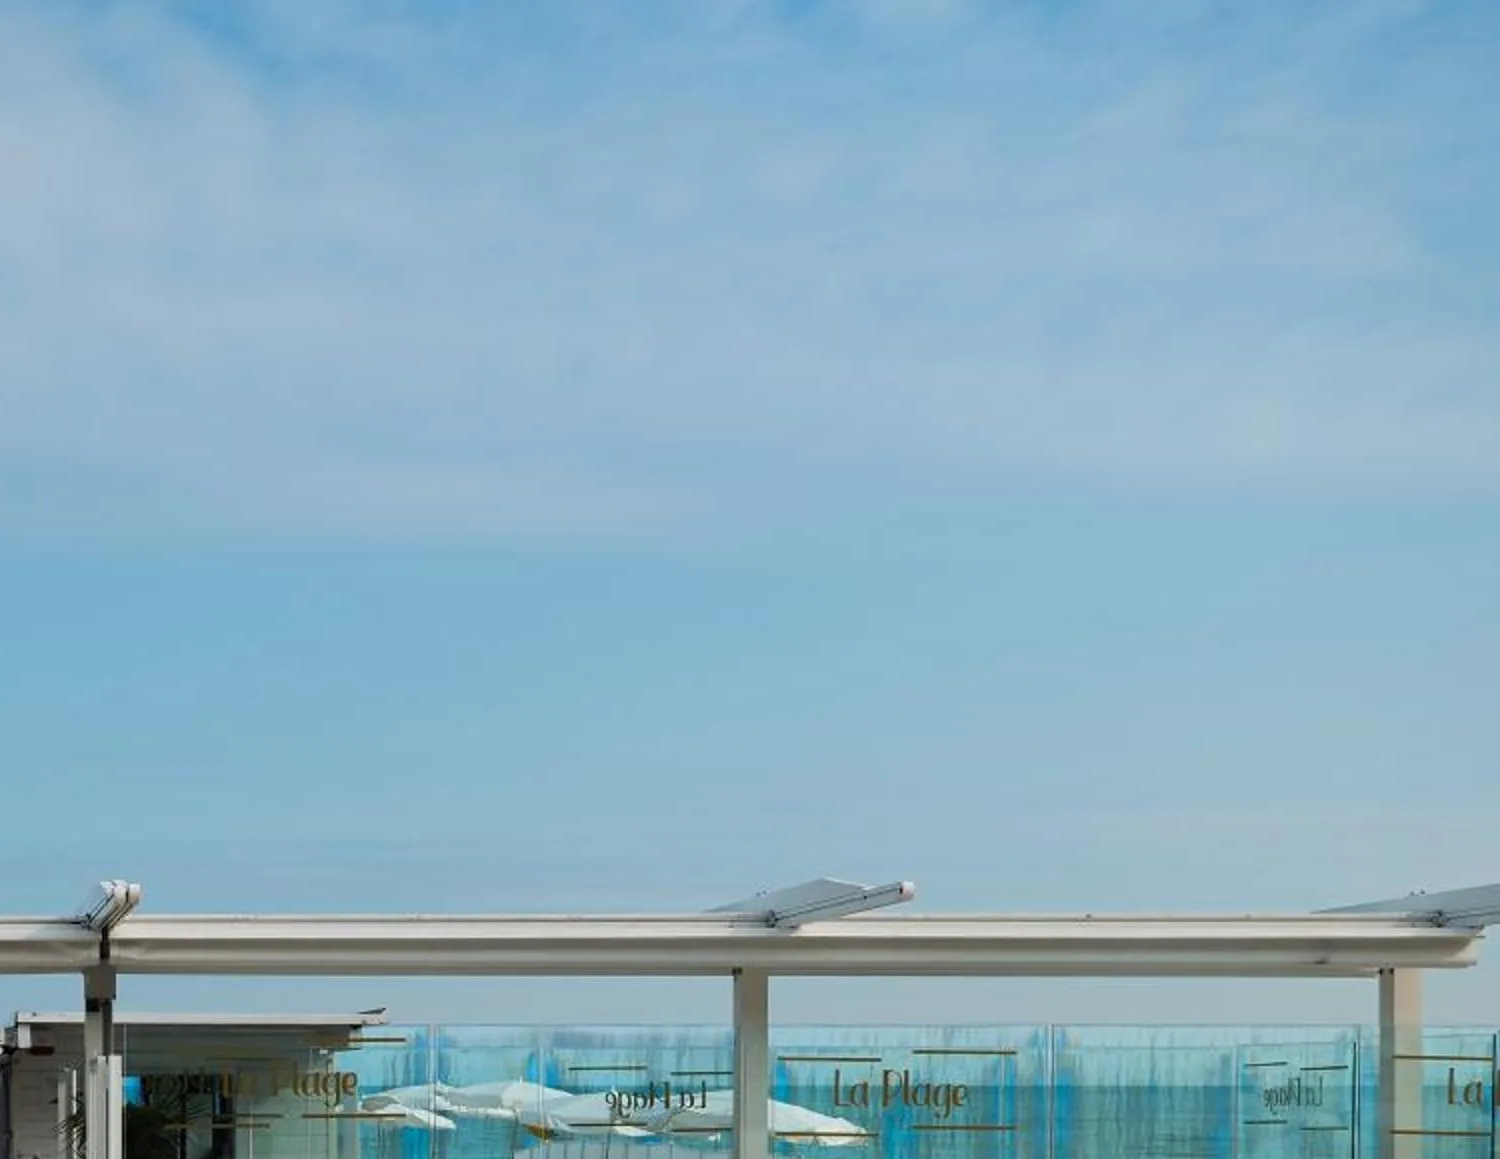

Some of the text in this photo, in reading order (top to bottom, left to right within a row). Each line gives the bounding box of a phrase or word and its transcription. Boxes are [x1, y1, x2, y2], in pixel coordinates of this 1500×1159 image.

[834, 1069, 969, 1119] La Plage
[1447, 1067, 1484, 1106] La
